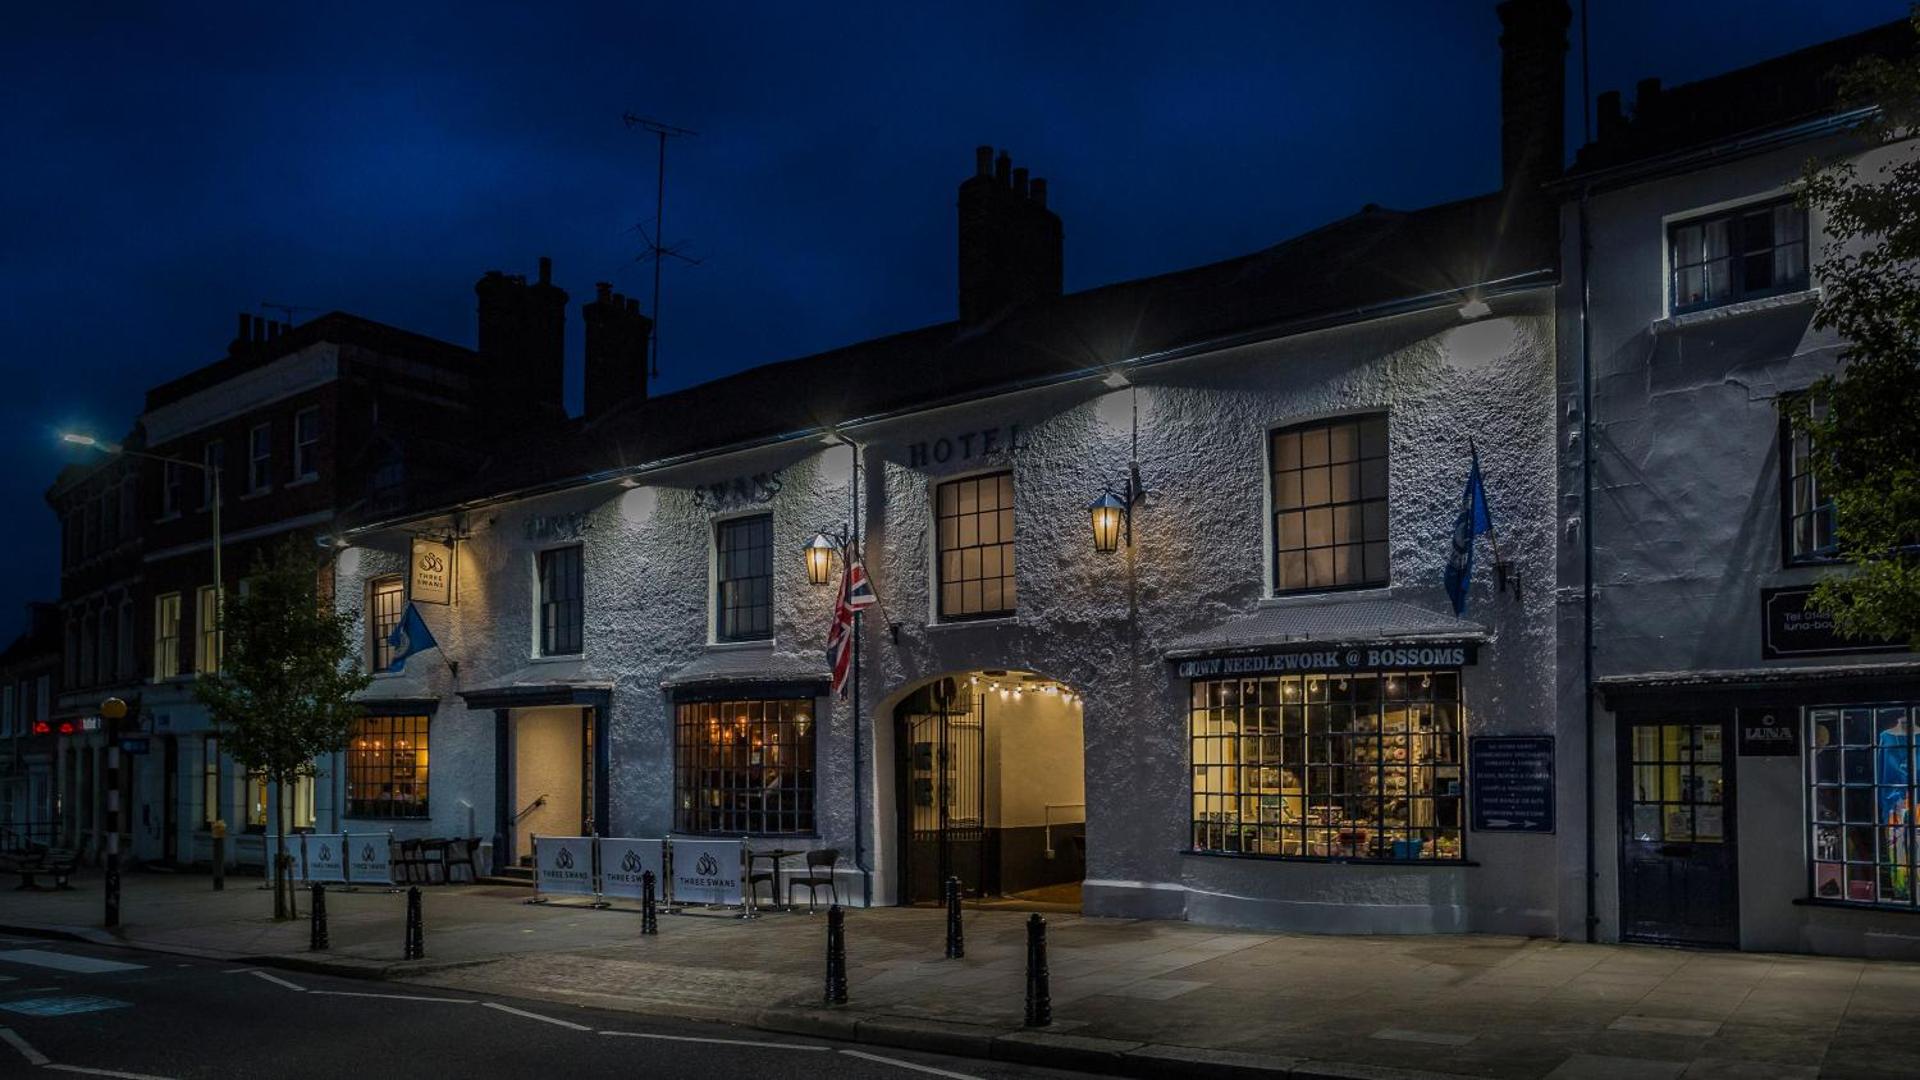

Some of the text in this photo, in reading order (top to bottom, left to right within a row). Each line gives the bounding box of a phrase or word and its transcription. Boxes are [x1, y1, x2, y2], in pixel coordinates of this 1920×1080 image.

[909, 424, 1029, 468] HOTEL
[419, 573, 442, 581] THREE
[417, 579, 443, 588] SWANS
[1178, 659, 1220, 678] CROWN
[1223, 651, 1339, 673] NEEDLEWORK
[1367, 647, 1465, 667] BOSSOMS
[1745, 727, 1792, 738] LUNA
[543, 870, 588, 880] THREE SWANS
[607, 873, 630, 881] THREE
[680, 877, 736, 888] THREE SWANS
